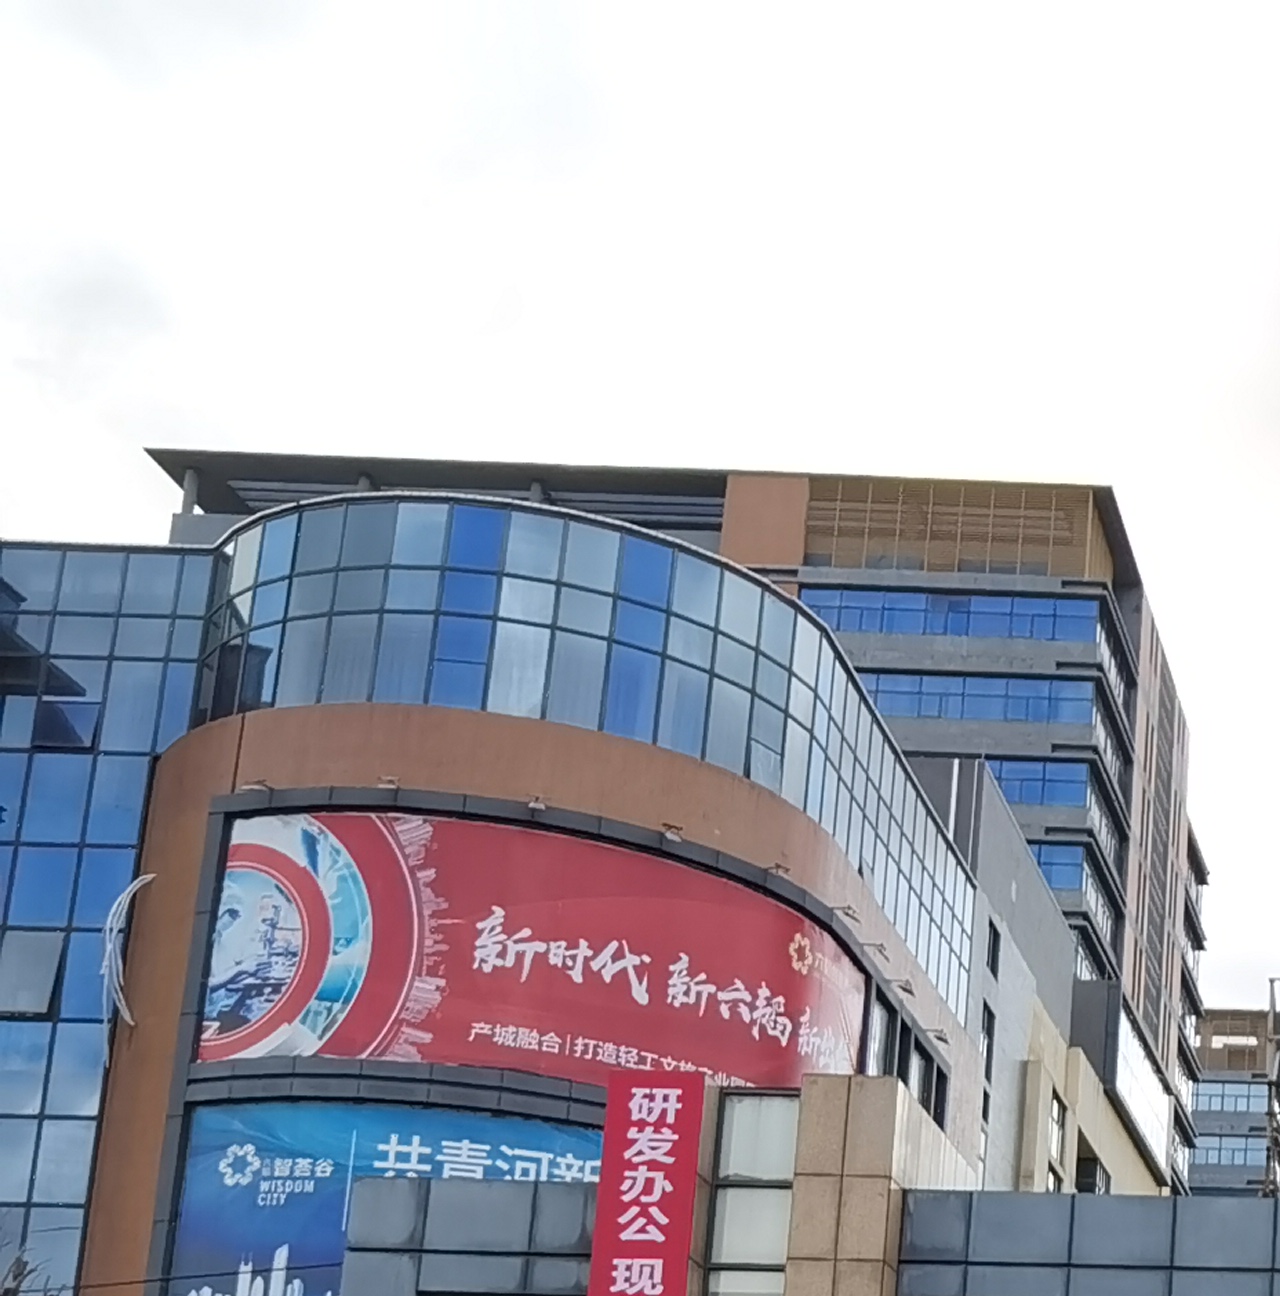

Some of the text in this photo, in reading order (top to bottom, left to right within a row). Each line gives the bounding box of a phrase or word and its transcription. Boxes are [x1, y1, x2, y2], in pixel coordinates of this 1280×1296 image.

[473, 905, 651, 1004] 新时代
[260, 1180, 315, 1194] WISDOM
[618, 1088, 683, 1243] 研发办公
[258, 1193, 287, 1206] CITY
